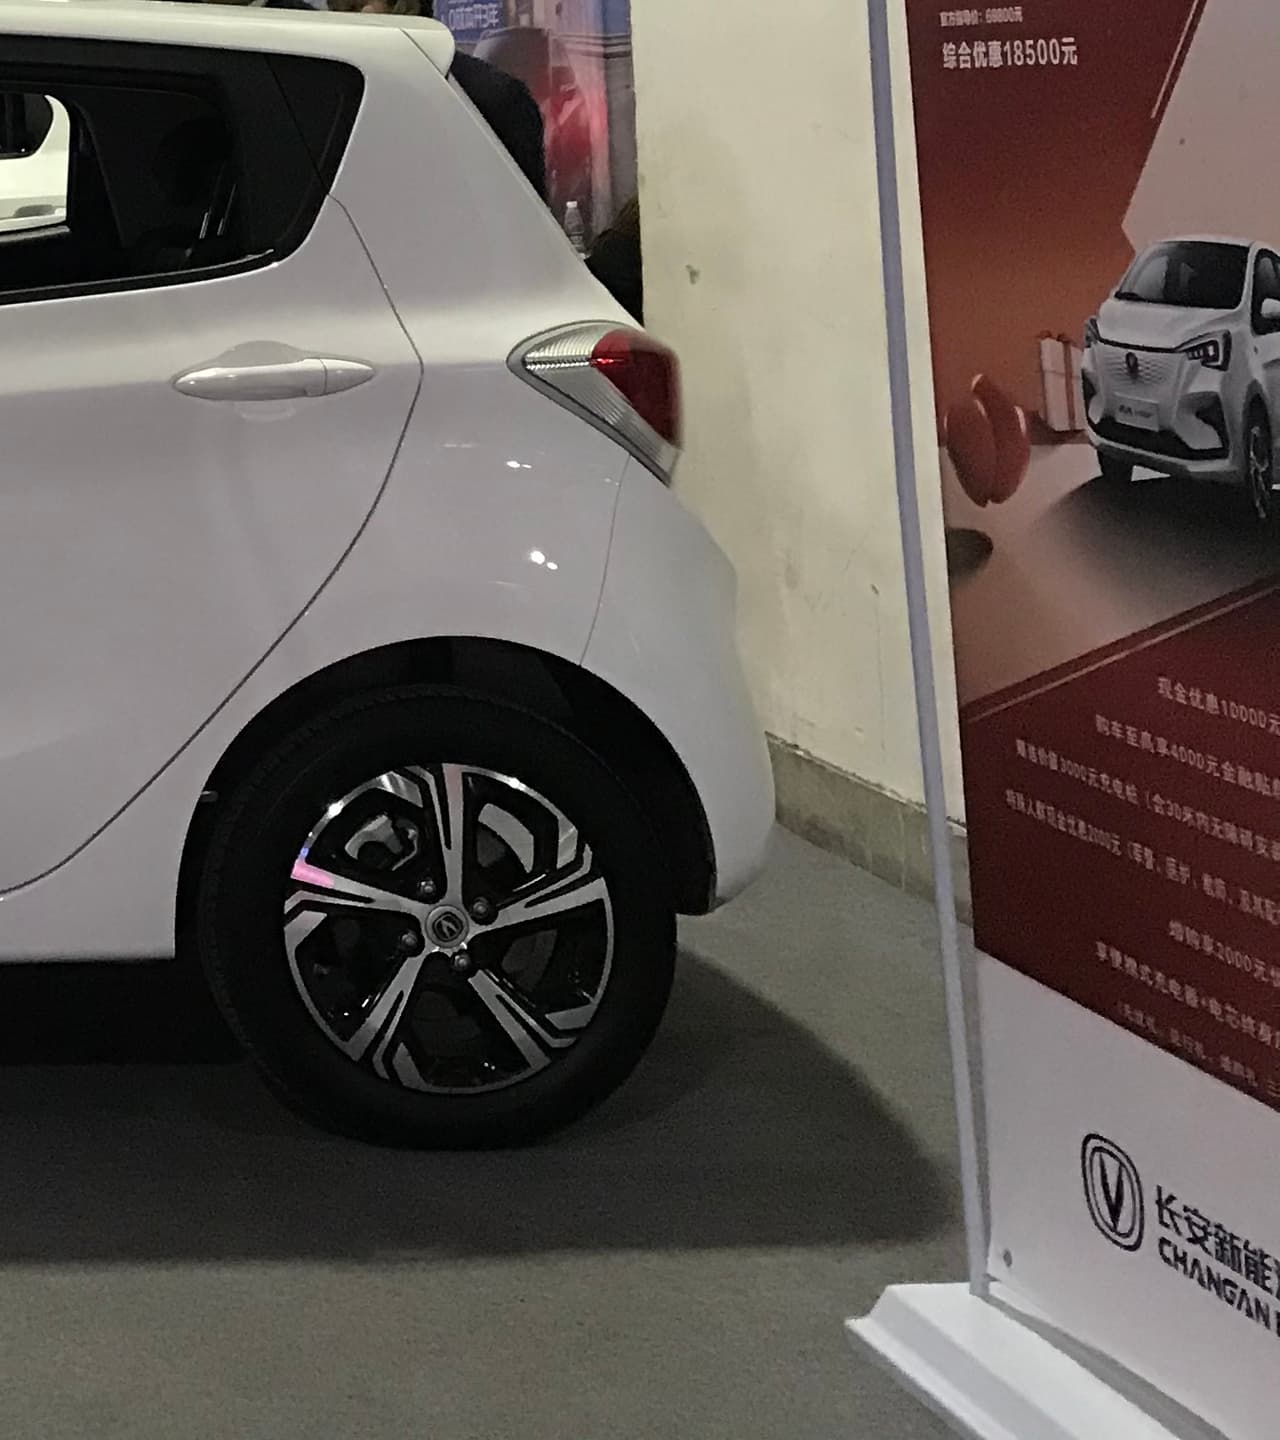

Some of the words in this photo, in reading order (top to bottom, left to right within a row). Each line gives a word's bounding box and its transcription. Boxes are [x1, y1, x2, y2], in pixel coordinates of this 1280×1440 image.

[942, 36, 1078, 70] 综合优惠18500元
[1158, 1235, 1272, 1332] CHANGAN
